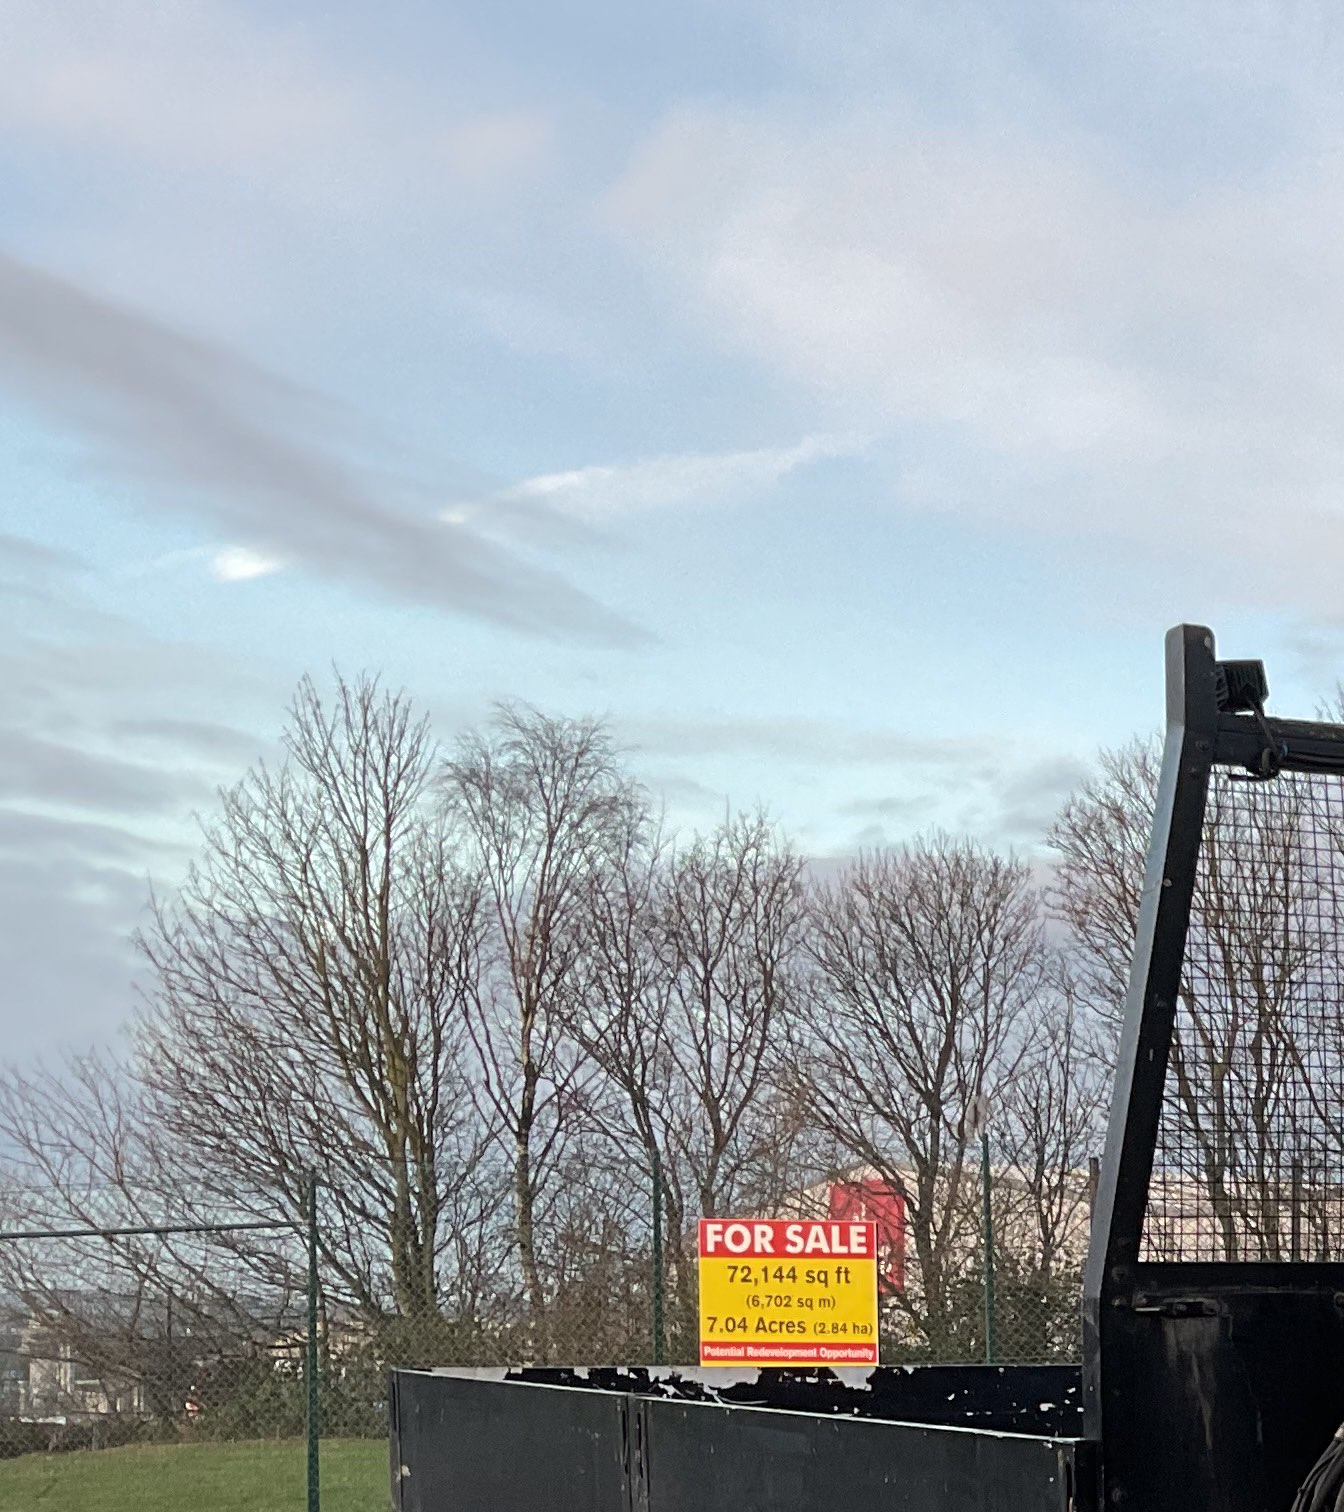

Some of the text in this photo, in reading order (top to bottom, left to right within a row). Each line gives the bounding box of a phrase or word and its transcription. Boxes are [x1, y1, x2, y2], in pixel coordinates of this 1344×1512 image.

[706, 1223, 868, 1254] FOR SALE
[727, 1265, 851, 1288] 72,144 sq ft
[746, 1294, 836, 1310] (6,702 sq m)
[706, 1316, 873, 1336] 7.04 Acres (2.84 ha)
[703, 1345, 875, 1361] Potential Redevelopment Opportunity
